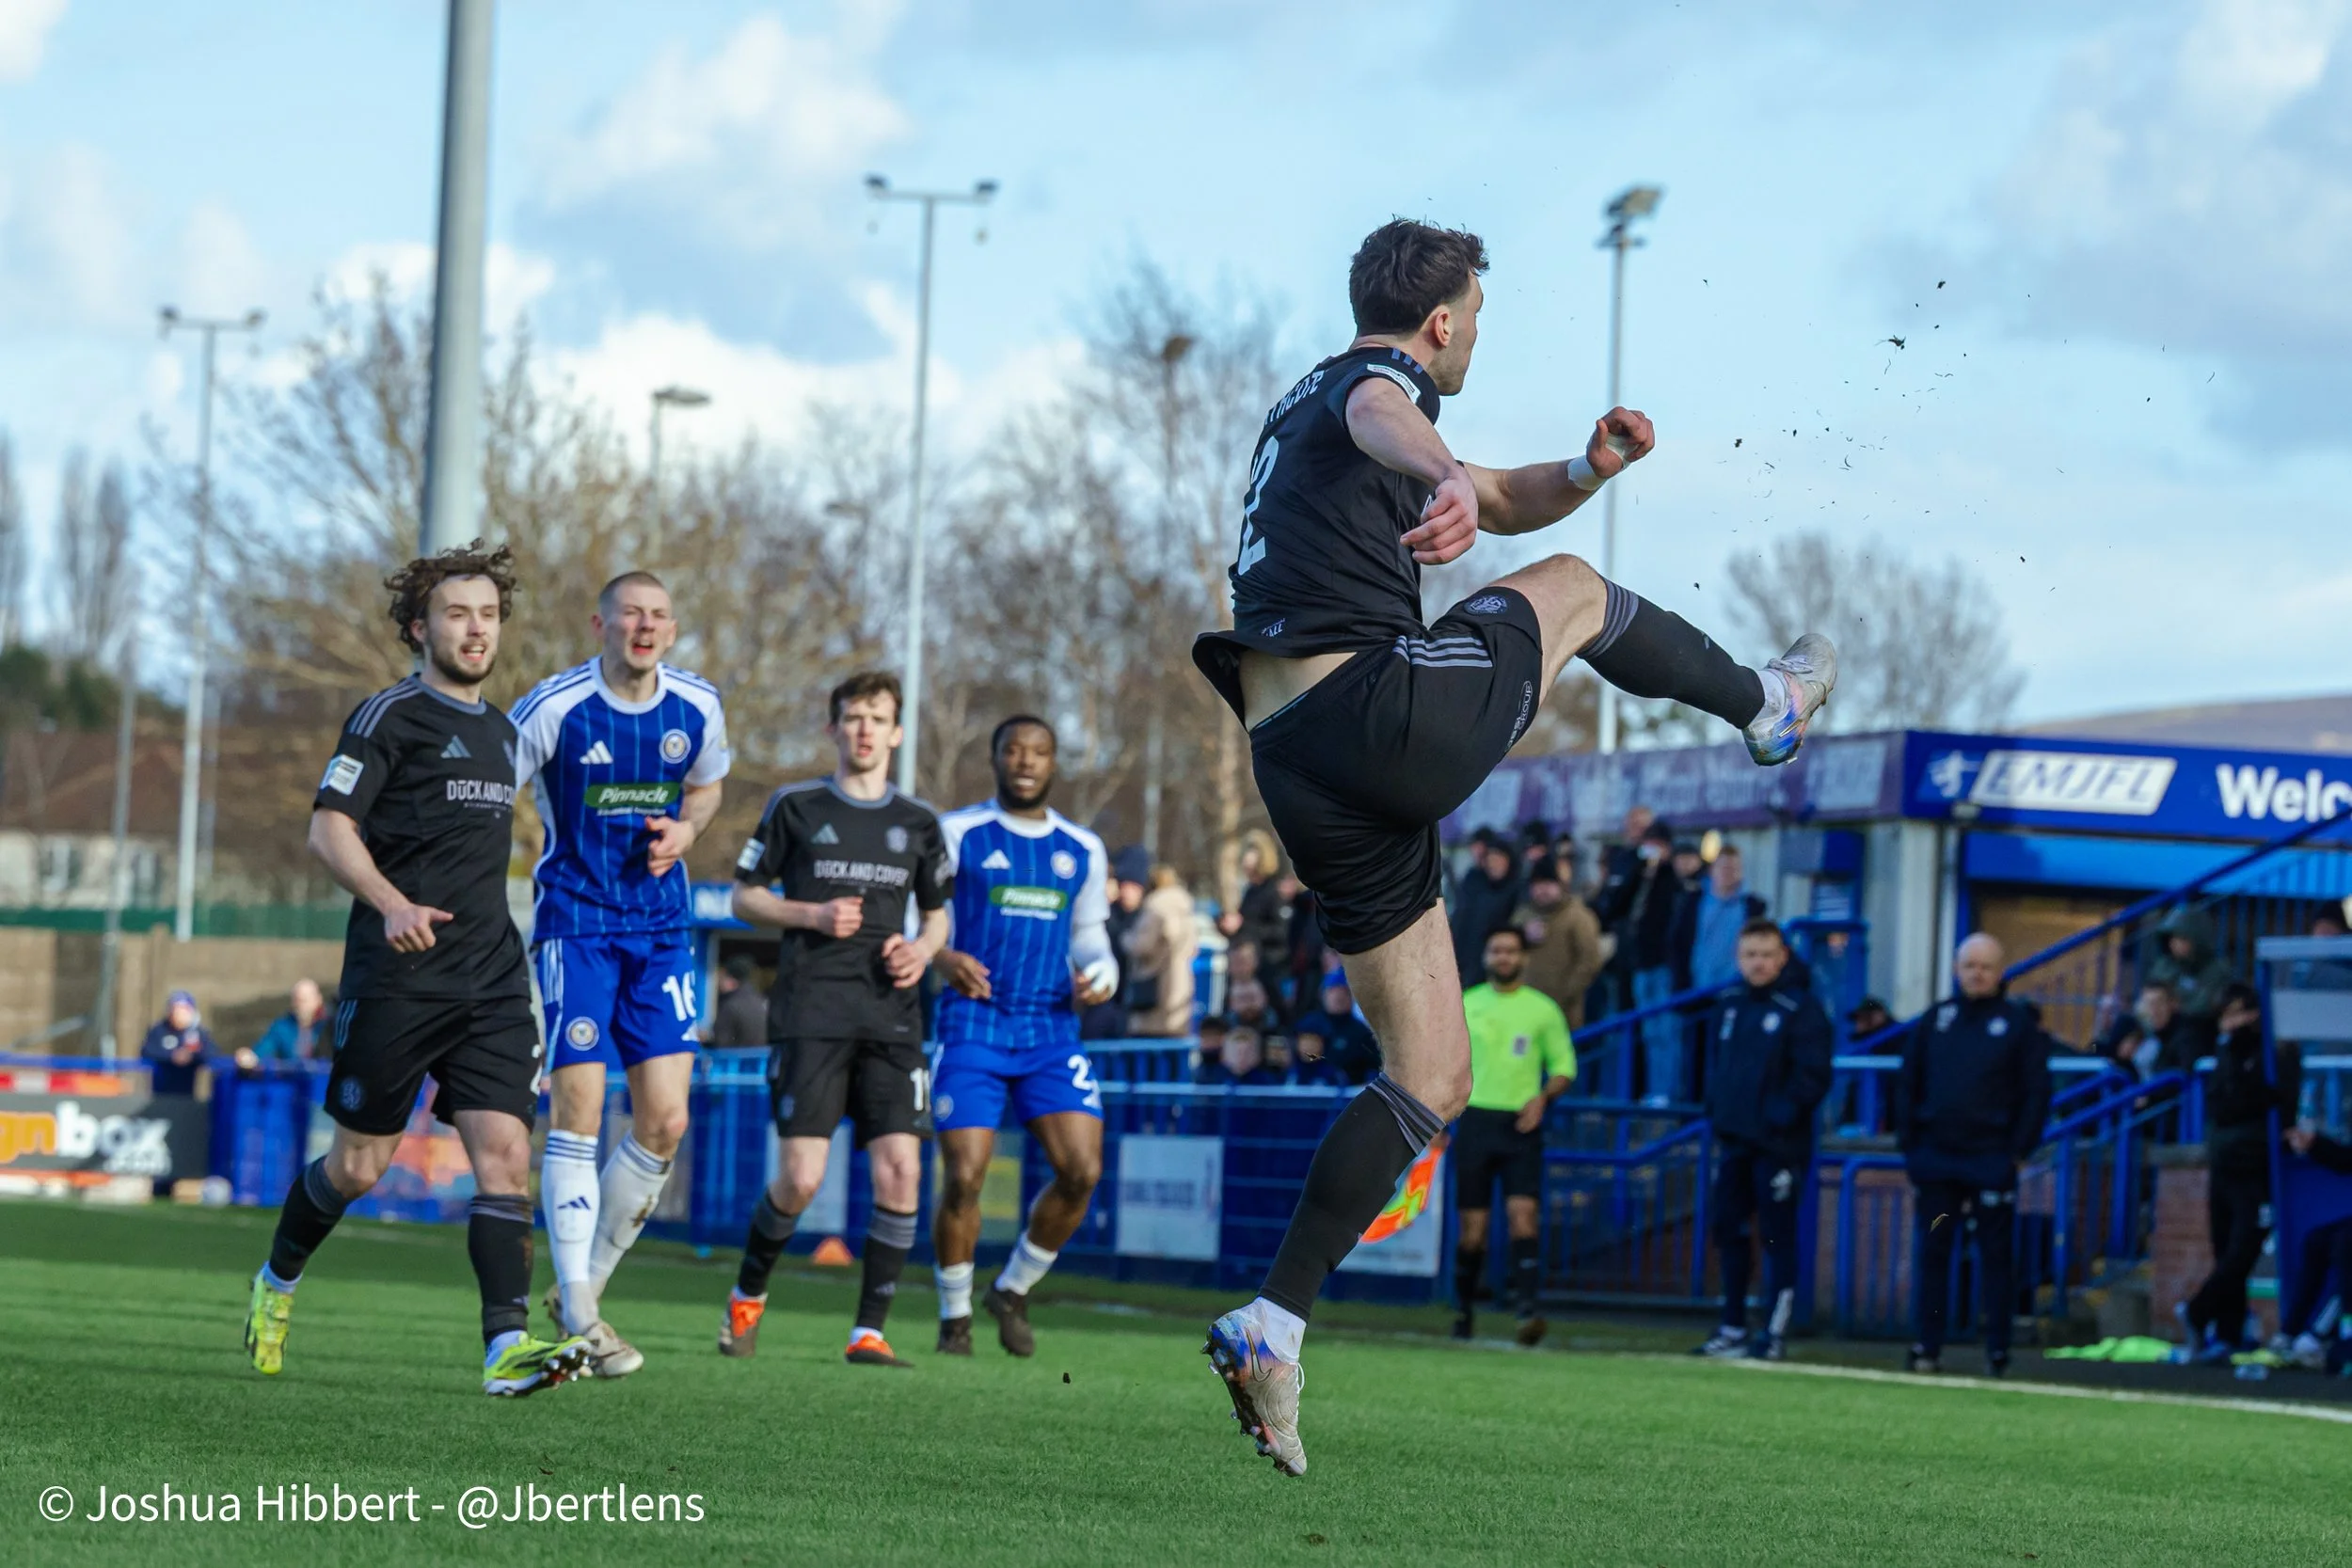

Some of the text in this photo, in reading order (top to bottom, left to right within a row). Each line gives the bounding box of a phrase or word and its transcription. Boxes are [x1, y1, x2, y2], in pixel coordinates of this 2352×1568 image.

[483, 782, 503, 802] AND
[1986, 755, 2160, 804] EMJFL
[598, 786, 669, 803] Pinnacle
[1067, 1053, 1094, 1091] 2
